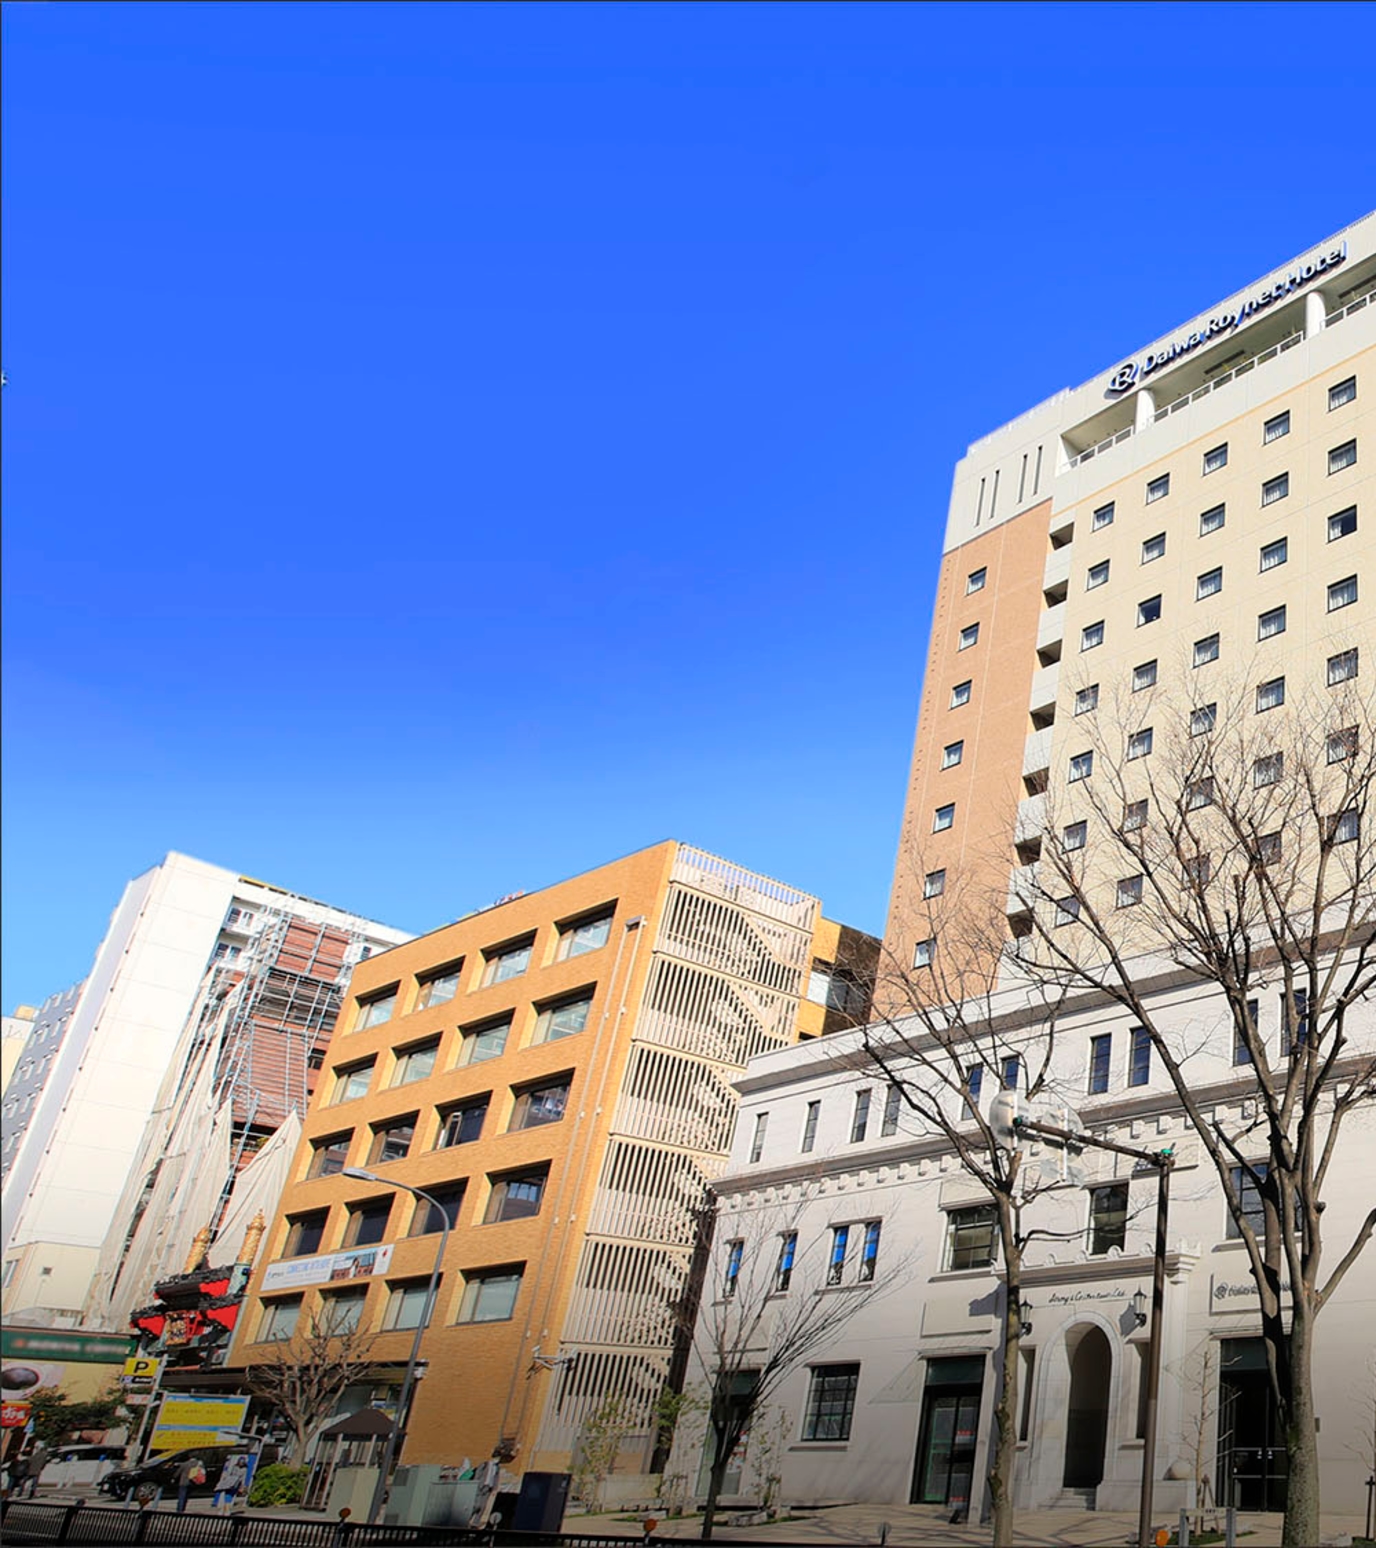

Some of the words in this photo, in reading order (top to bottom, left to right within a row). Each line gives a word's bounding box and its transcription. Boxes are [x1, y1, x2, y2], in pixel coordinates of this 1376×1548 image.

[1143, 331, 1202, 374] Daiwa
[1205, 281, 1287, 339] Roynet
[1285, 241, 1347, 291] Hotel
[133, 1361, 149, 1373] P
